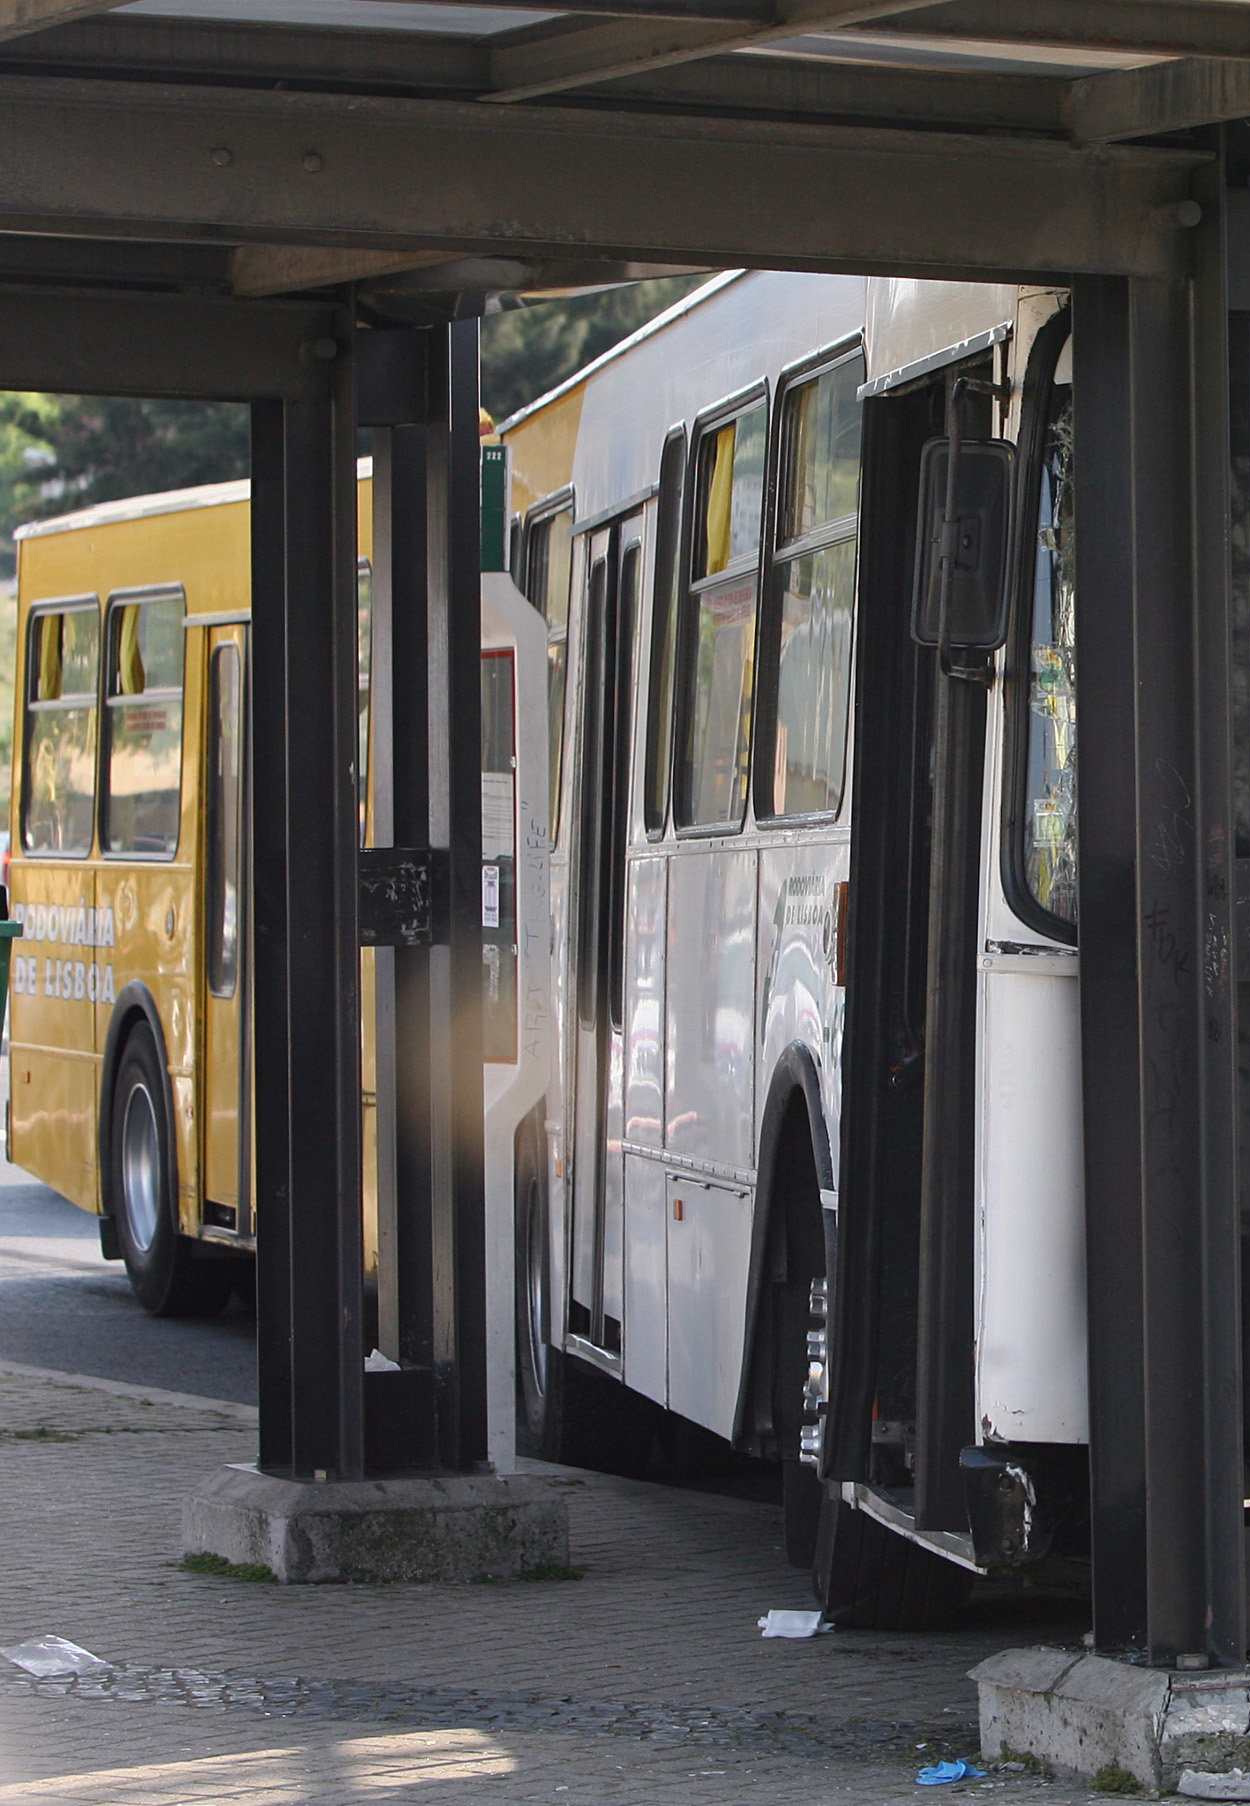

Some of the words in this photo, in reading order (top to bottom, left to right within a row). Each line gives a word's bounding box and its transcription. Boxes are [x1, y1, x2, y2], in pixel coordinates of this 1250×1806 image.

[486, 451, 502, 461] 222
[786, 905, 796, 925] DE
[797, 905, 824, 925] LISBOA
[14, 955, 37, 996] DE
[44, 957, 116, 1005] LISBOA
